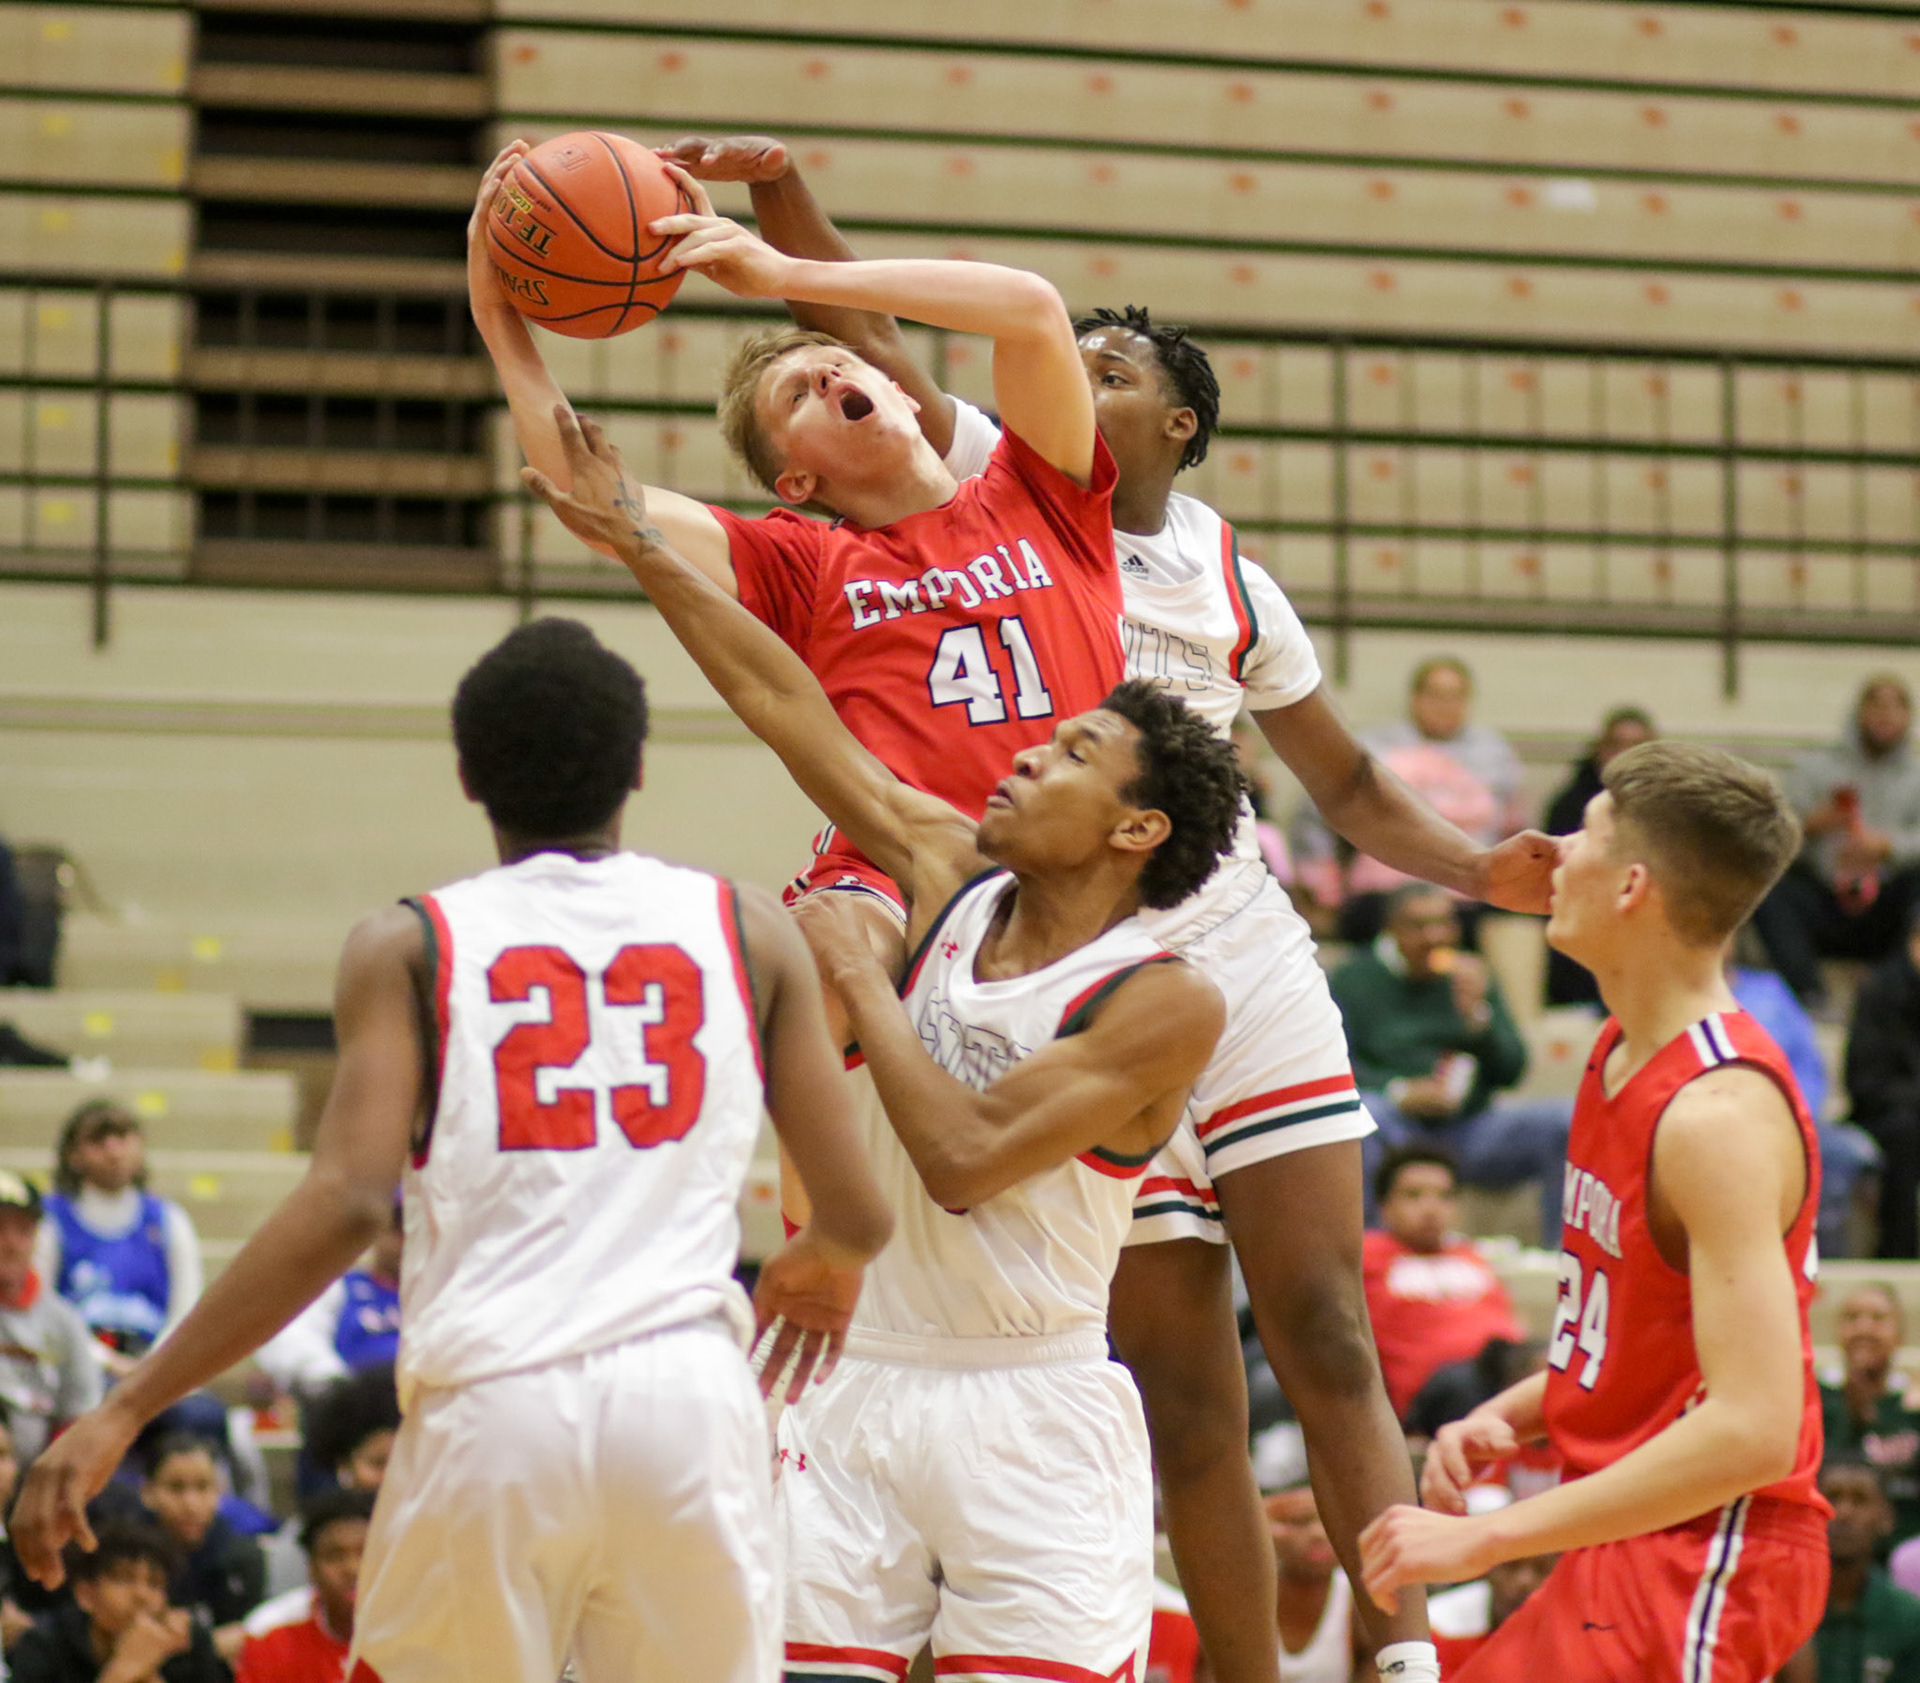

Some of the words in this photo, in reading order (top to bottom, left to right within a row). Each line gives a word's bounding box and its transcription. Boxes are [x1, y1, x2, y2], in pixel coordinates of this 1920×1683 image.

[843, 538, 1053, 631] EMPORIA
[926, 614, 1054, 727] 41
[486, 942, 706, 1152] 23
[1547, 1248, 1610, 1392] 24
